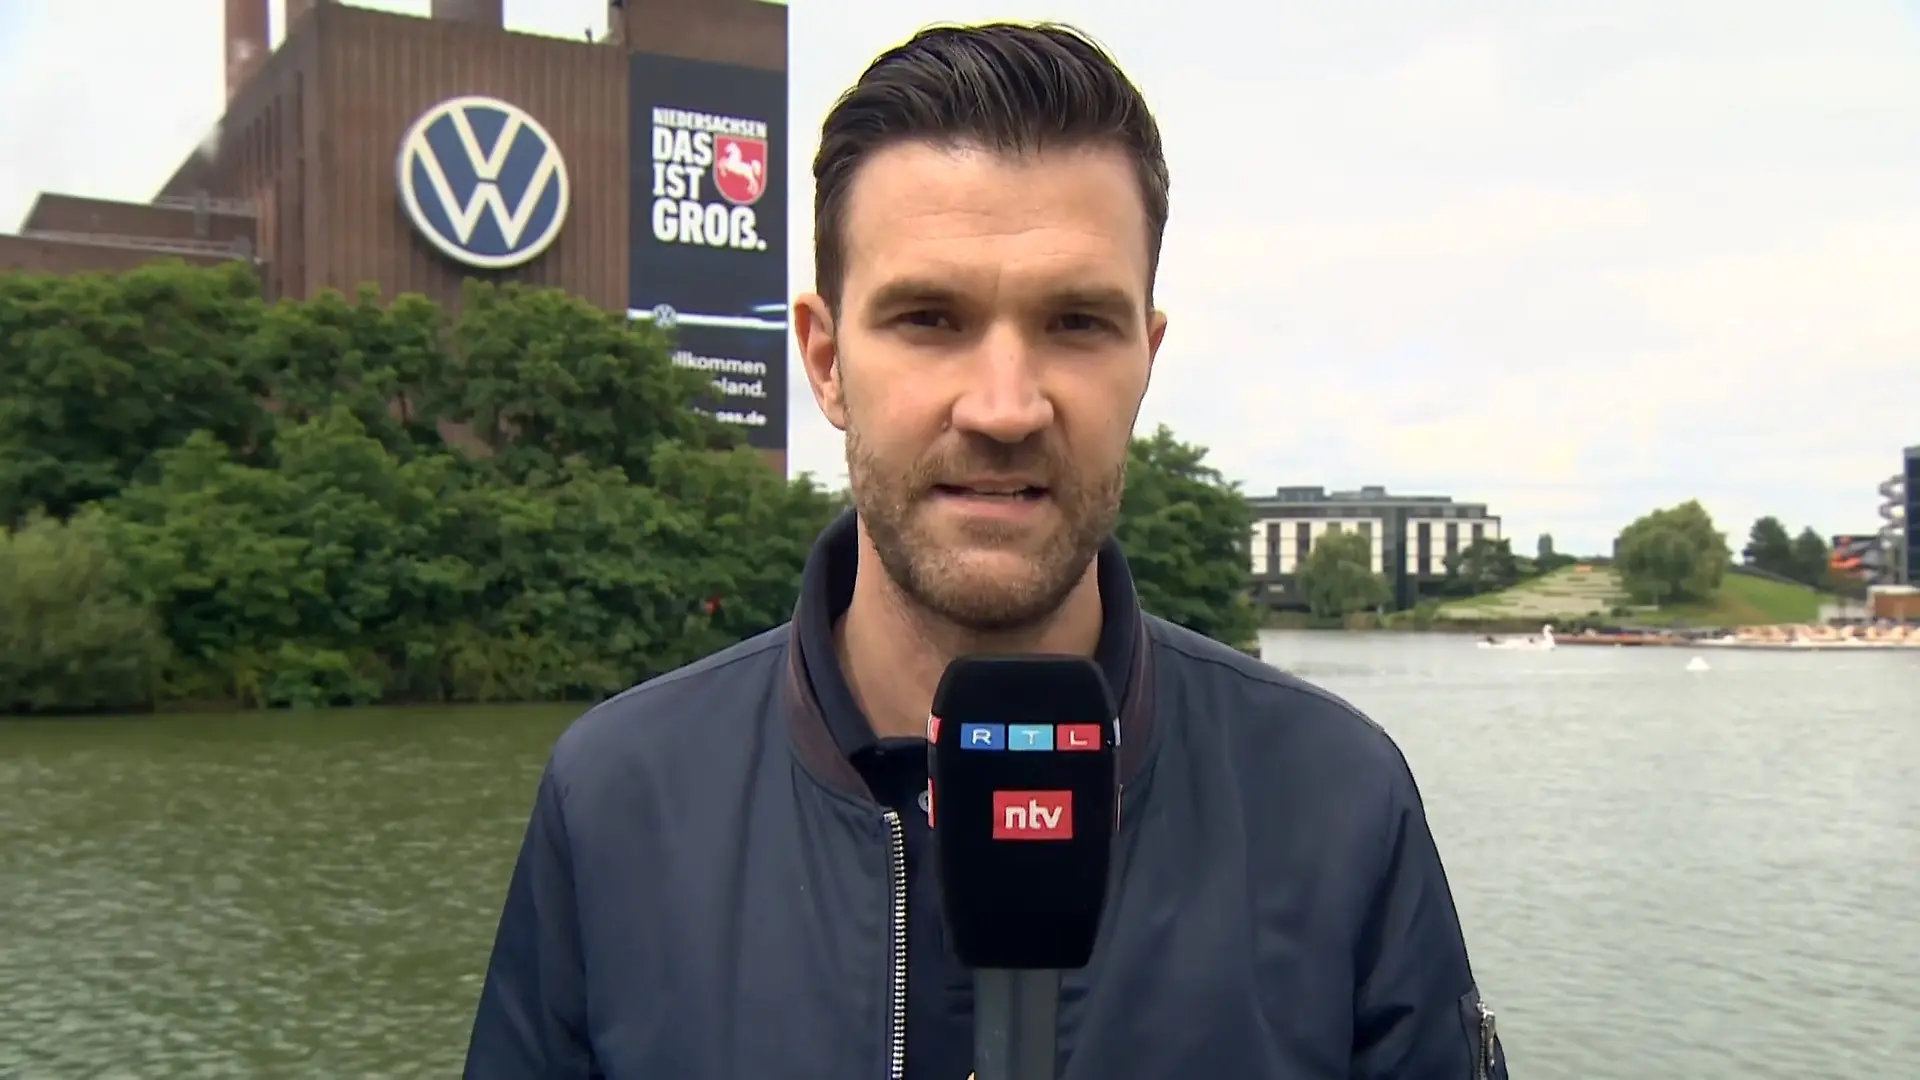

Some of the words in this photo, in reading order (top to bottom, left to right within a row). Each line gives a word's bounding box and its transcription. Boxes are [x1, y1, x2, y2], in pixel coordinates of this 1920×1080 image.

[652, 107, 768, 138] NIEDERSACHSEN
[652, 126, 713, 167] DAS
[652, 162, 705, 201] IST
[672, 351, 767, 376] illkommen
[971, 728, 1088, 746] RTL
[1005, 799, 1062, 829] ntv
